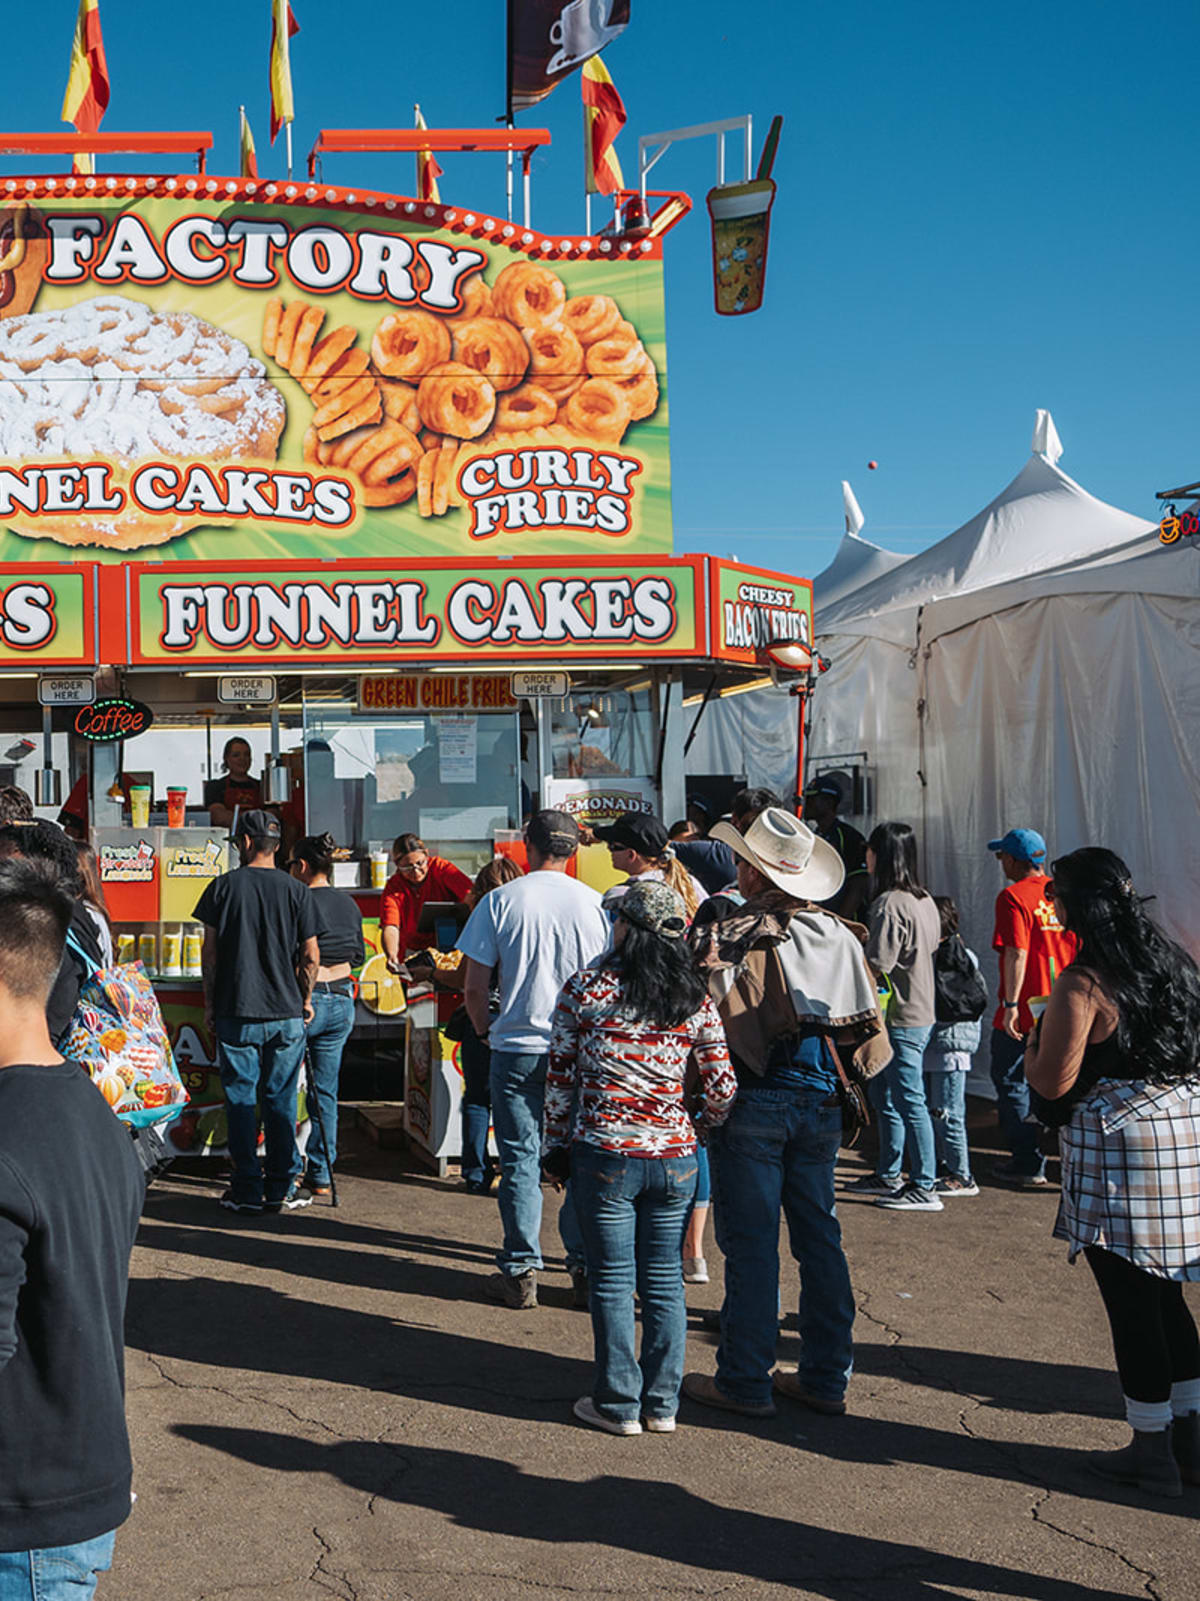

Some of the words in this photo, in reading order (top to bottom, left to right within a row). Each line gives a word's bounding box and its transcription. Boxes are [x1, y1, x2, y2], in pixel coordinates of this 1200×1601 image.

[43, 213, 486, 311] FACTORY
[459, 449, 642, 498] CURLY
[132, 465, 355, 526] CAKES
[470, 489, 631, 536] FRIES
[738, 584, 793, 607] CHEESY
[160, 582, 439, 649] FUNNEL
[447, 579, 676, 642] CAKES
[724, 602, 770, 649] BACON
[50, 681, 84, 690] ORDER
[230, 679, 263, 689] ORDER
[233, 689, 260, 699] HERE
[362, 676, 418, 708] GREEN
[420, 676, 470, 708] CHILE
[522, 675, 556, 684] ORDER
[526, 684, 553, 694] HERE
[54, 690, 81, 700] HERE
[73, 704, 144, 734] Coffee
